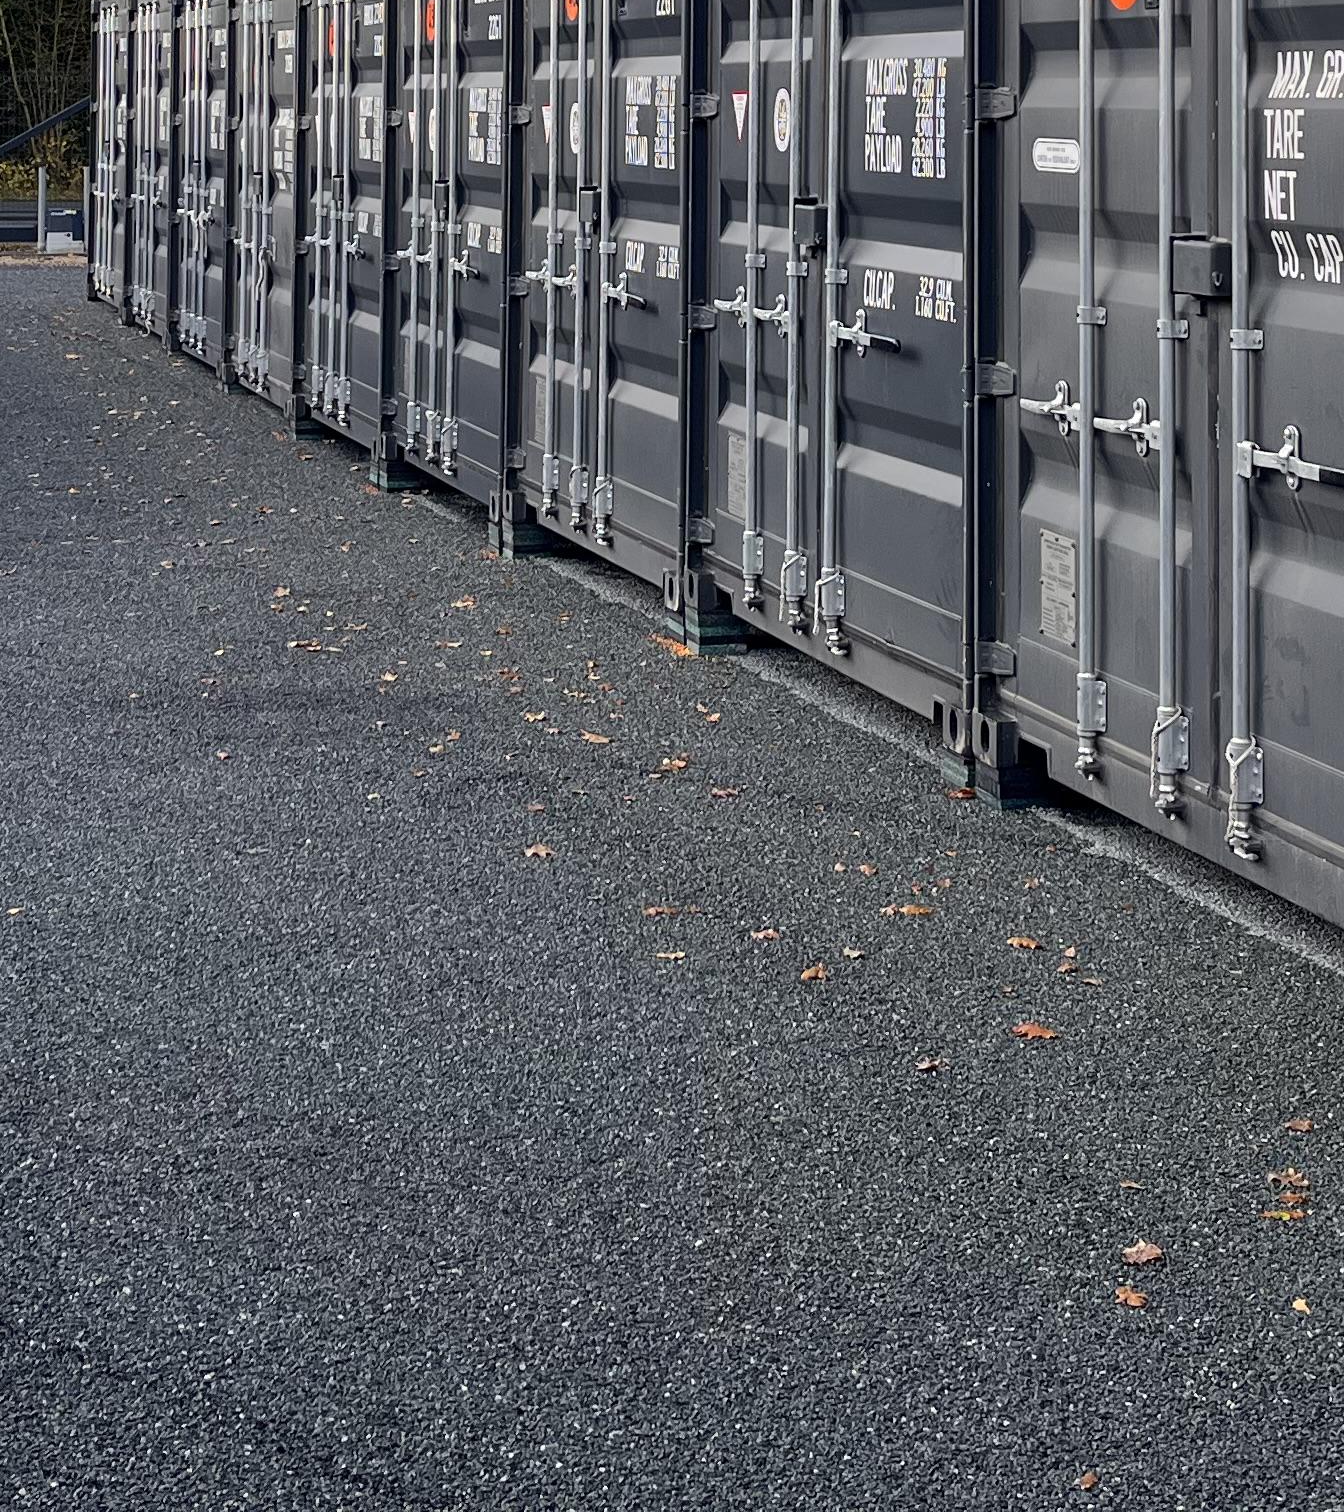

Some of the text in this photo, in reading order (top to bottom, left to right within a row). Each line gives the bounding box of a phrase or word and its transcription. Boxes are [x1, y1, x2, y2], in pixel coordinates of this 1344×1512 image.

[1268, 50, 1313, 99] MAX.
[865, 96, 887, 134] TARE
[1263, 108, 1305, 160] TARE
[864, 134, 902, 174] PAYLOAD
[1263, 169, 1297, 221] NET
[1270, 230, 1305, 280] CU.
